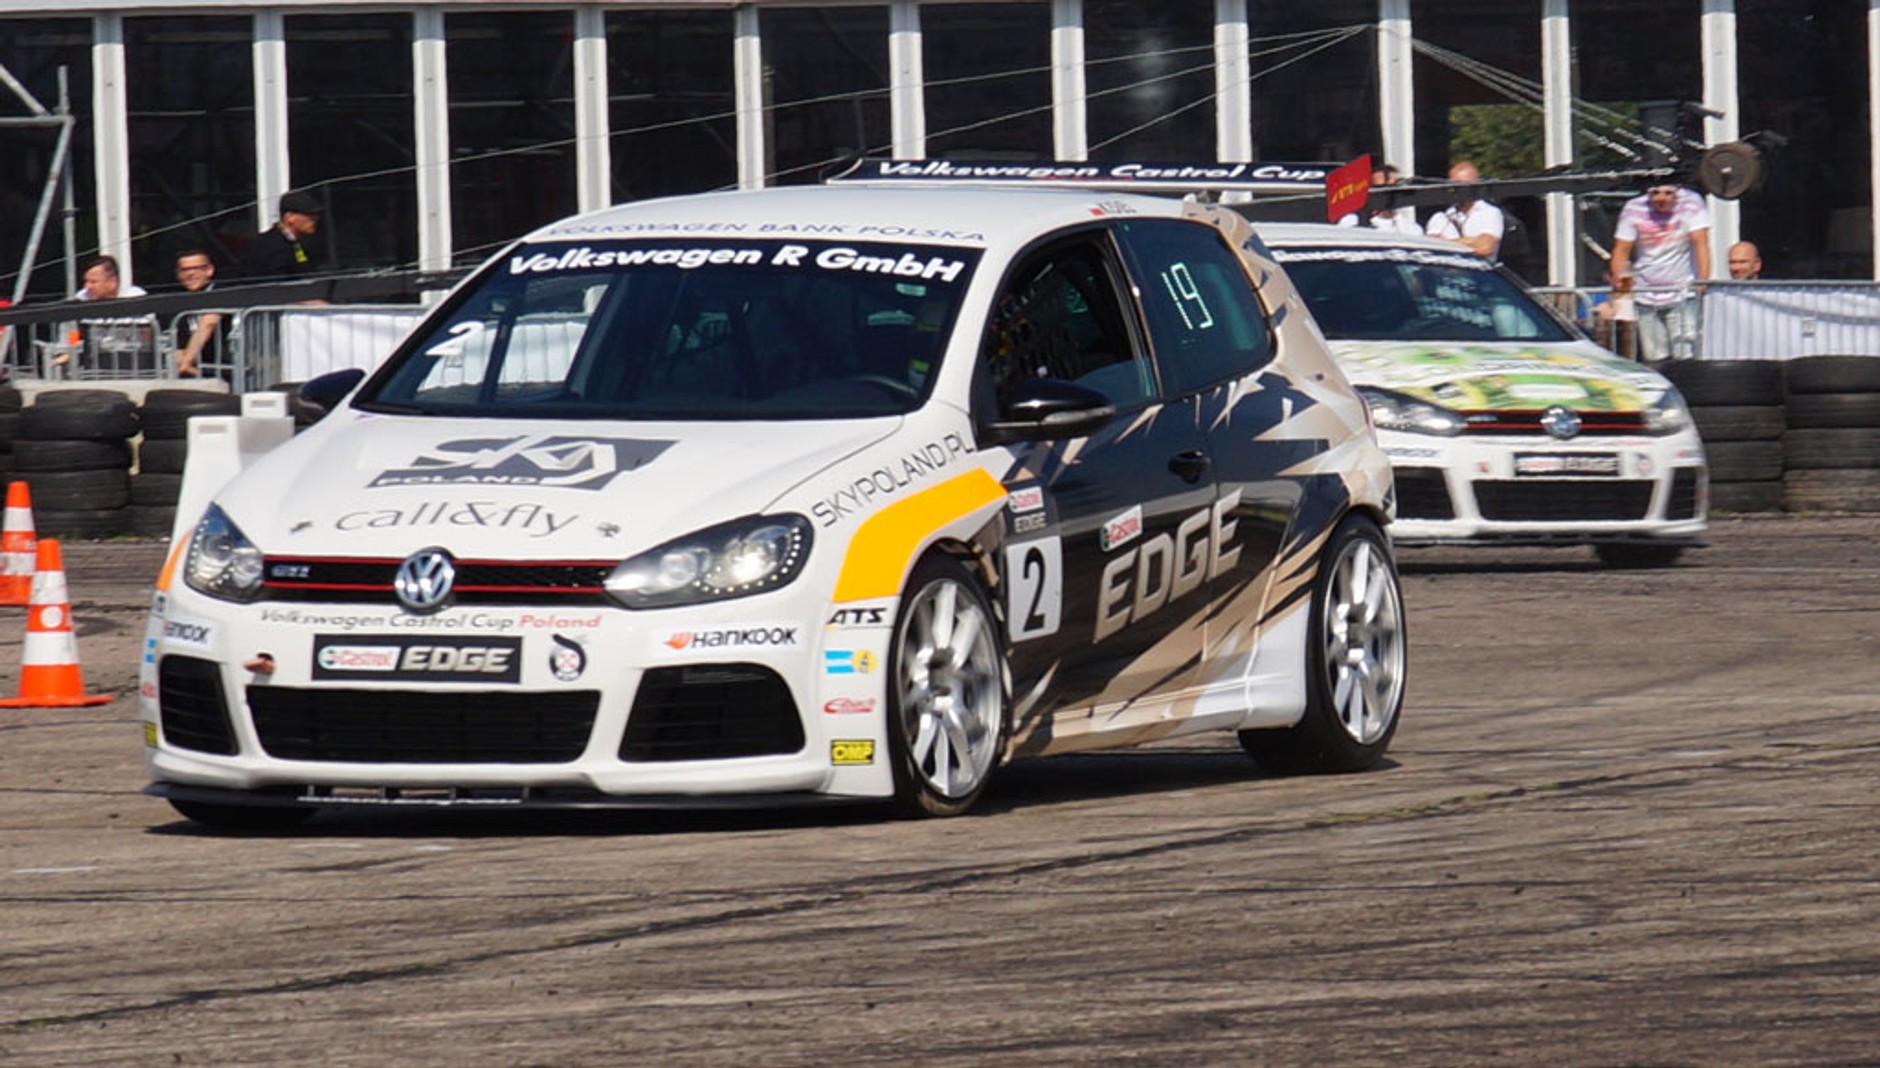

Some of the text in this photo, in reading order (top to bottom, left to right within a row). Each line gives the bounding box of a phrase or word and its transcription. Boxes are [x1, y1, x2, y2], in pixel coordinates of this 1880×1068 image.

[879, 161, 1099, 178] Volkswagen
[1110, 164, 1246, 178] Castrol
[1252, 166, 1325, 180] Cup
[550, 222, 985, 241] VOLKSWAGEN BANK POLSKA
[510, 244, 965, 282] Volkswagen R GmbH
[1161, 262, 1214, 331] 19
[424, 320, 486, 357] 2
[811, 431, 976, 529] SKYPOLAND.PL
[334, 501, 582, 538] call&fly
[1014, 511, 1047, 533] EDGE
[1092, 486, 1244, 645] EDGE
[1022, 546, 1046, 633] 2
[260, 609, 603, 631] Volkswagen Castrol Cup Poland
[826, 607, 888, 625] ATS
[400, 647, 516, 673] EDGE
[832, 745, 873, 762] OMP
